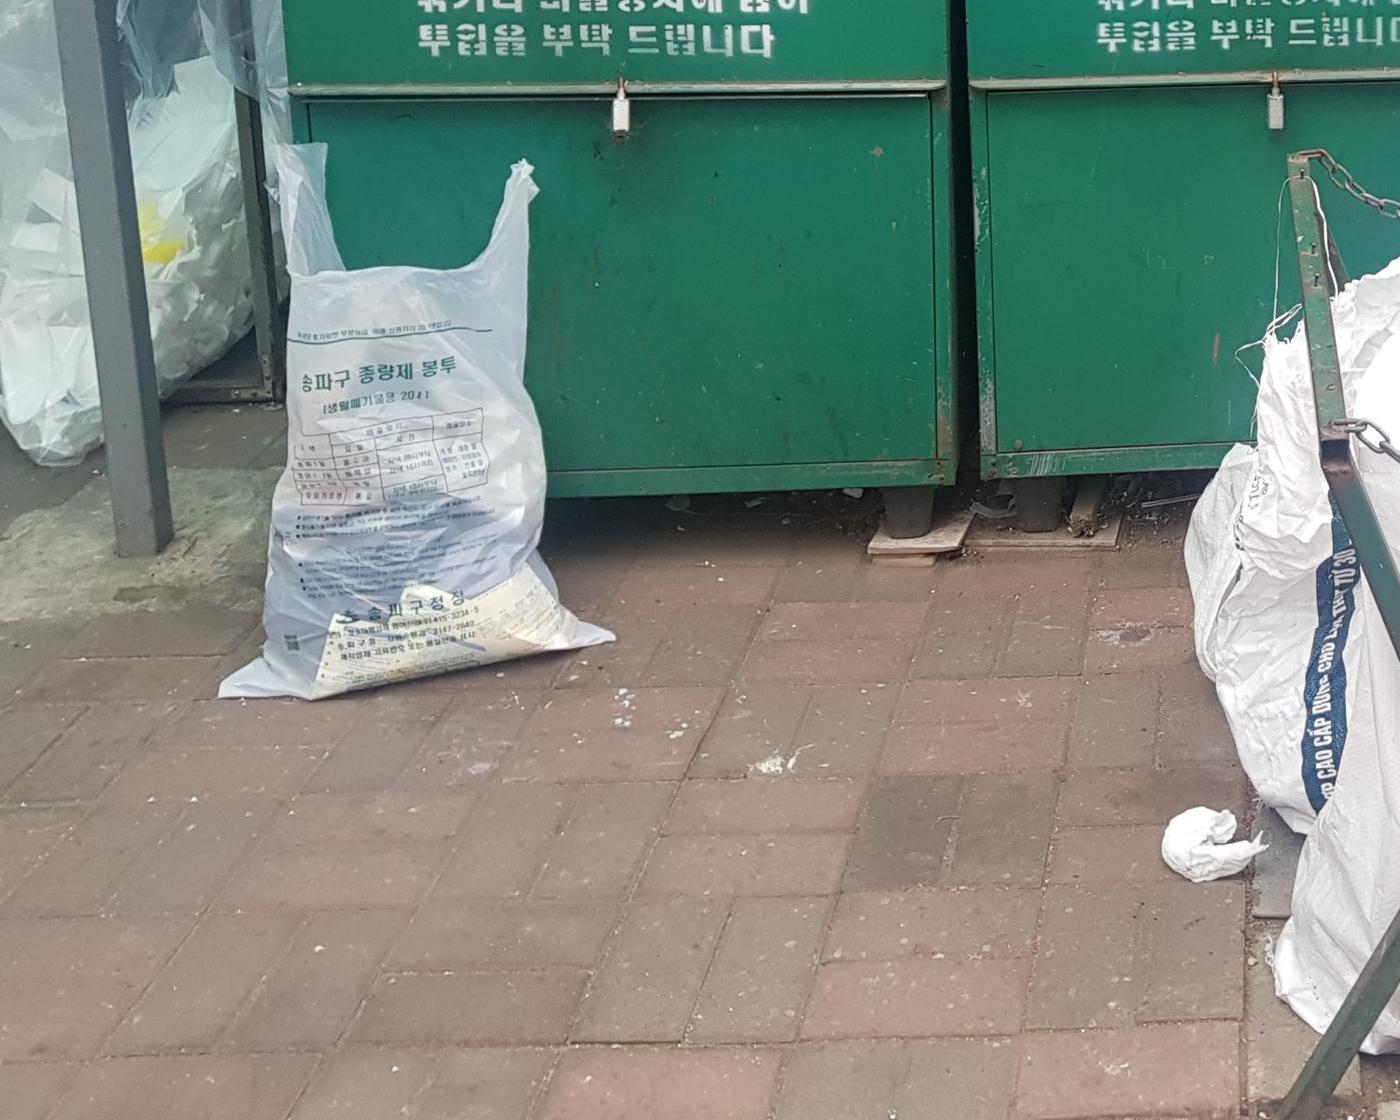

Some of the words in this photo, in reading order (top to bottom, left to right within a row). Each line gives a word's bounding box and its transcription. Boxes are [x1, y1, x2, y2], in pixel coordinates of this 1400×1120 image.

[419, 24, 526, 56] 투입을
[543, 24, 612, 55] 부탁
[629, 24, 775, 58] 드립니다
[1097, 21, 1195, 53] 투입을
[1211, 19, 1274, 49] 부탁
[302, 370, 350, 392] 송파구
[359, 363, 413, 384] 종량제
[421, 356, 456, 378] 봉투
[1333, 549, 1357, 567] 30
[368, 590, 464, 621] 송파구청장
[1318, 642, 1336, 674] CHO
[1315, 749, 1337, 780] CAO
